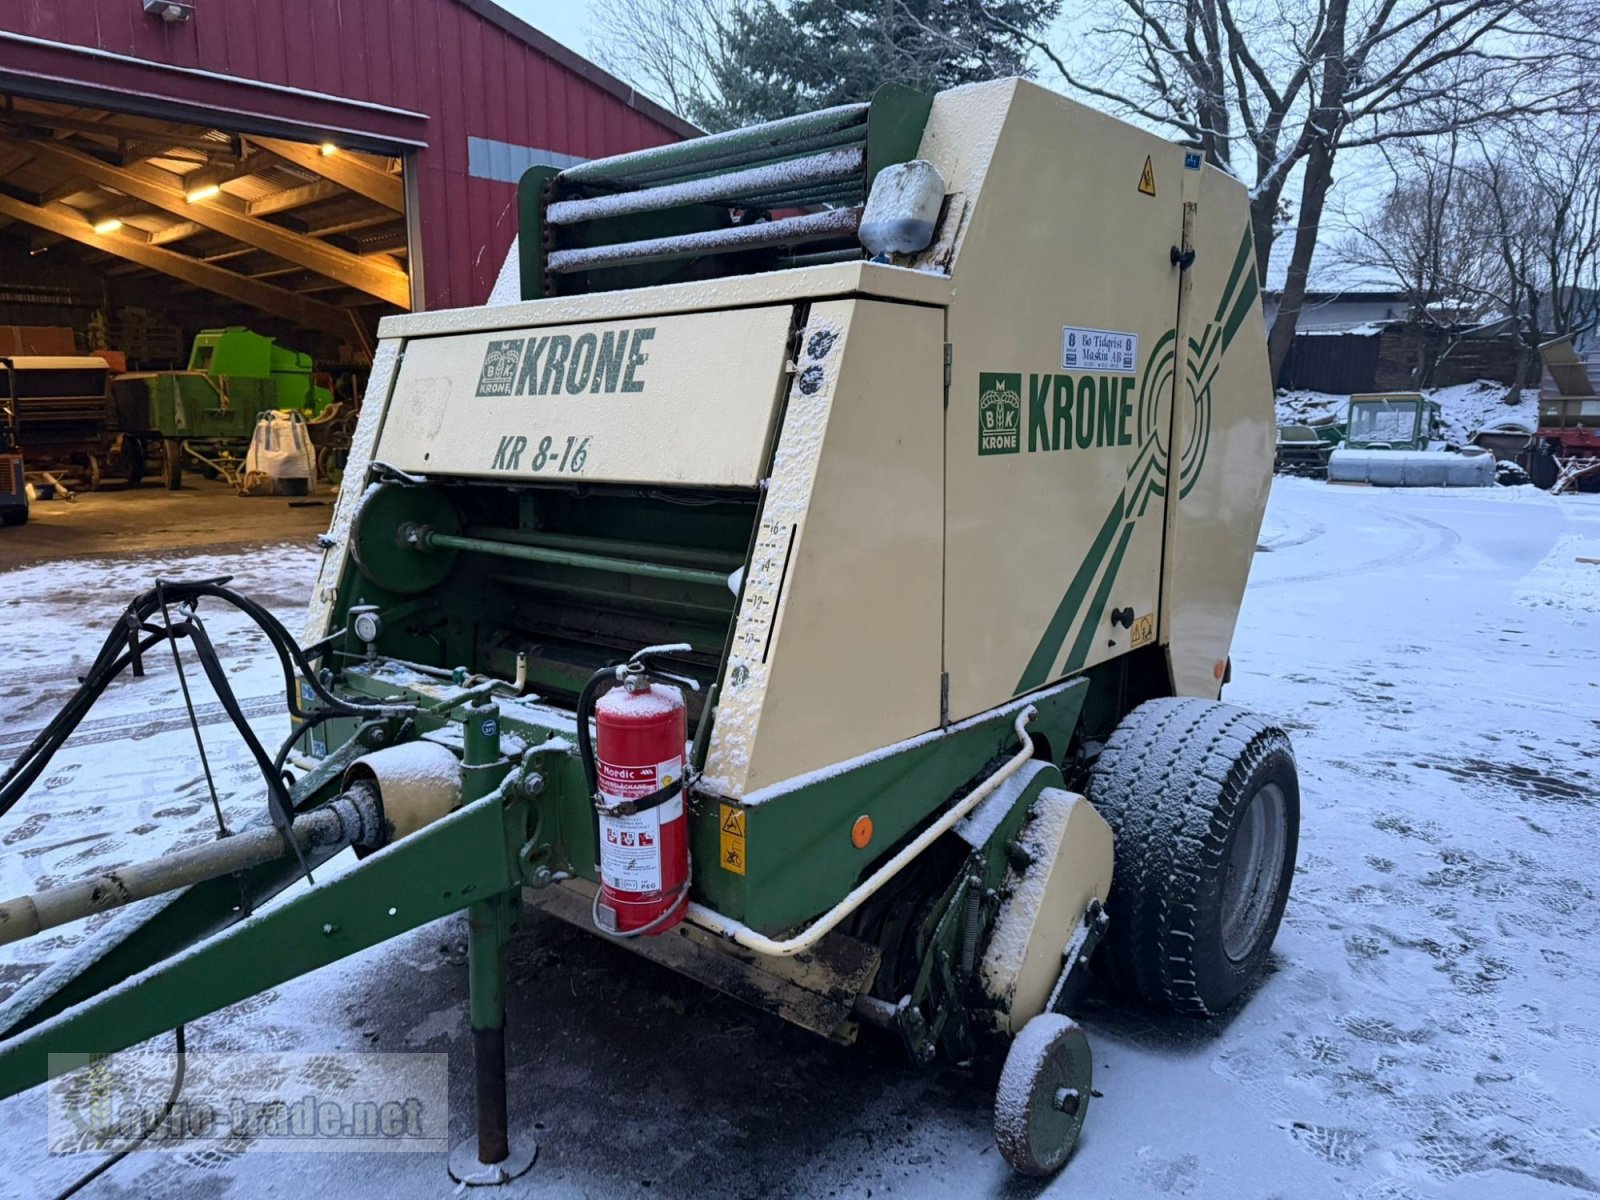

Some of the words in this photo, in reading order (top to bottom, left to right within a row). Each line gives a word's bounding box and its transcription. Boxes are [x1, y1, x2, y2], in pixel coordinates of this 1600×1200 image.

[1082, 334, 1092, 346] Bo
[515, 327, 656, 396] KRONE
[1082, 348, 1109, 361] Maskin
[1110, 352, 1122, 363] AB
[480, 383, 511, 394] KRONE
[1028, 373, 1135, 453] KRONE
[982, 436, 1017, 449] KRONE
[491, 435, 527, 470] KR
[532, 435, 592, 473] 8-16
[603, 765, 635, 779] Nordic
